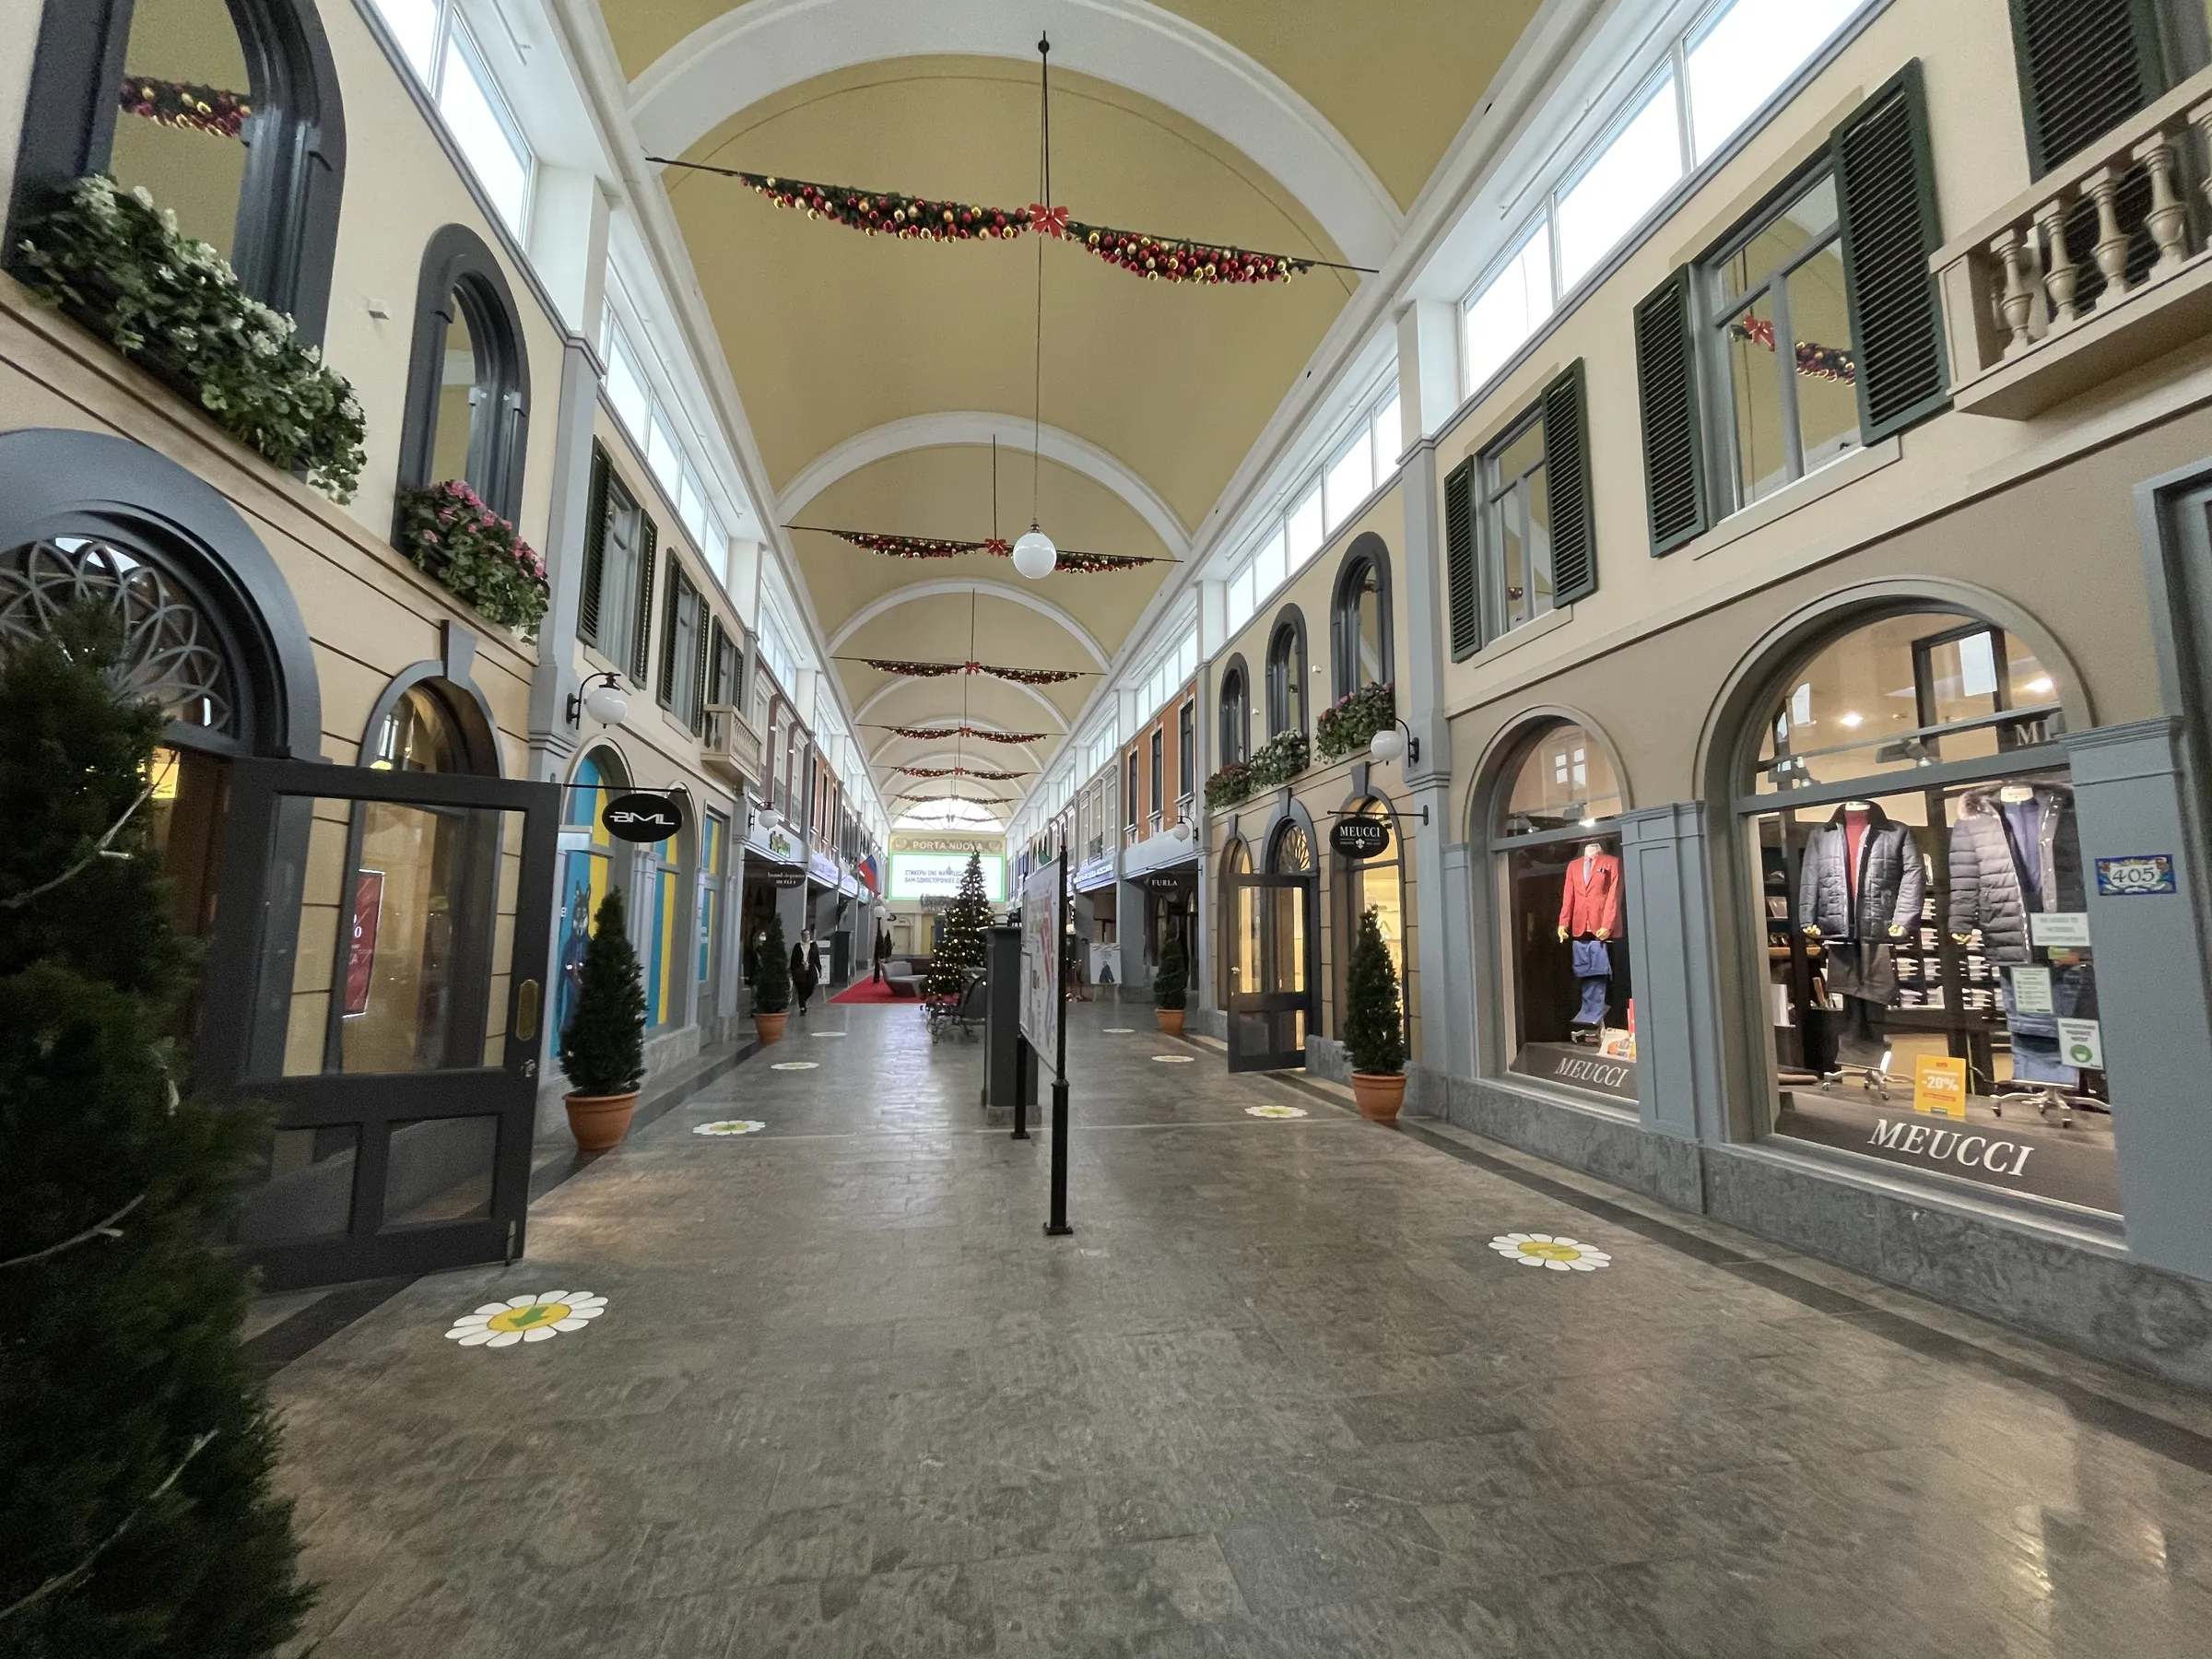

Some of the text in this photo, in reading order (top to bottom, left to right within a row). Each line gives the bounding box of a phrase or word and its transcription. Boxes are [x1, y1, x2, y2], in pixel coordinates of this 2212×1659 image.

[609, 812, 676, 825] BML
[1339, 826, 1381, 837] MEUCCI
[912, 841, 983, 851] PORTA NUOVA
[2112, 867, 2155, 883] 405
[1553, 1057, 1630, 1088] MEUCCI
[1922, 1076, 1959, 1091] -20%
[1866, 1118, 2035, 1177] MEUCCI
